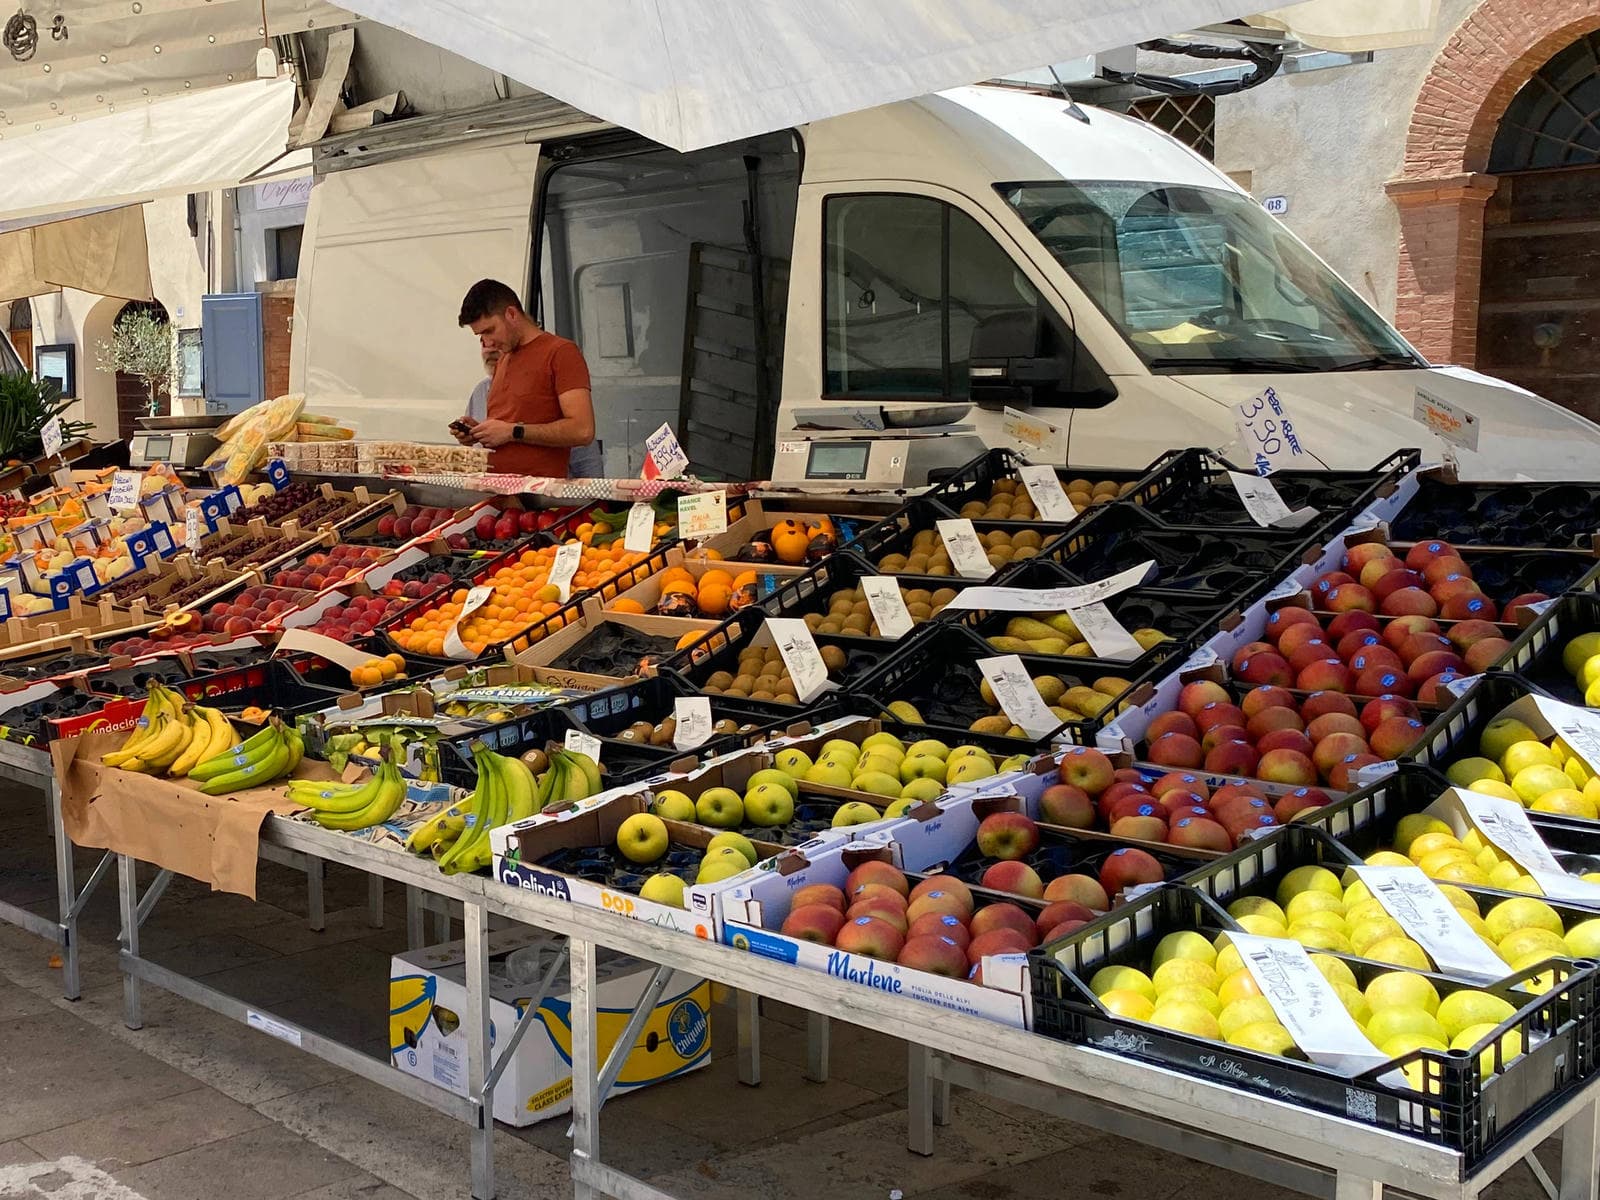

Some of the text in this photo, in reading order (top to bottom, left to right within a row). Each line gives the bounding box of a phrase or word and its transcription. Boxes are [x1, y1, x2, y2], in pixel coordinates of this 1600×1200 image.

[1240, 397, 1281, 454] 3,90
[601, 890, 634, 913] DOP
[828, 951, 902, 994] Marlene
[676, 1017, 708, 1055] Chiquita
